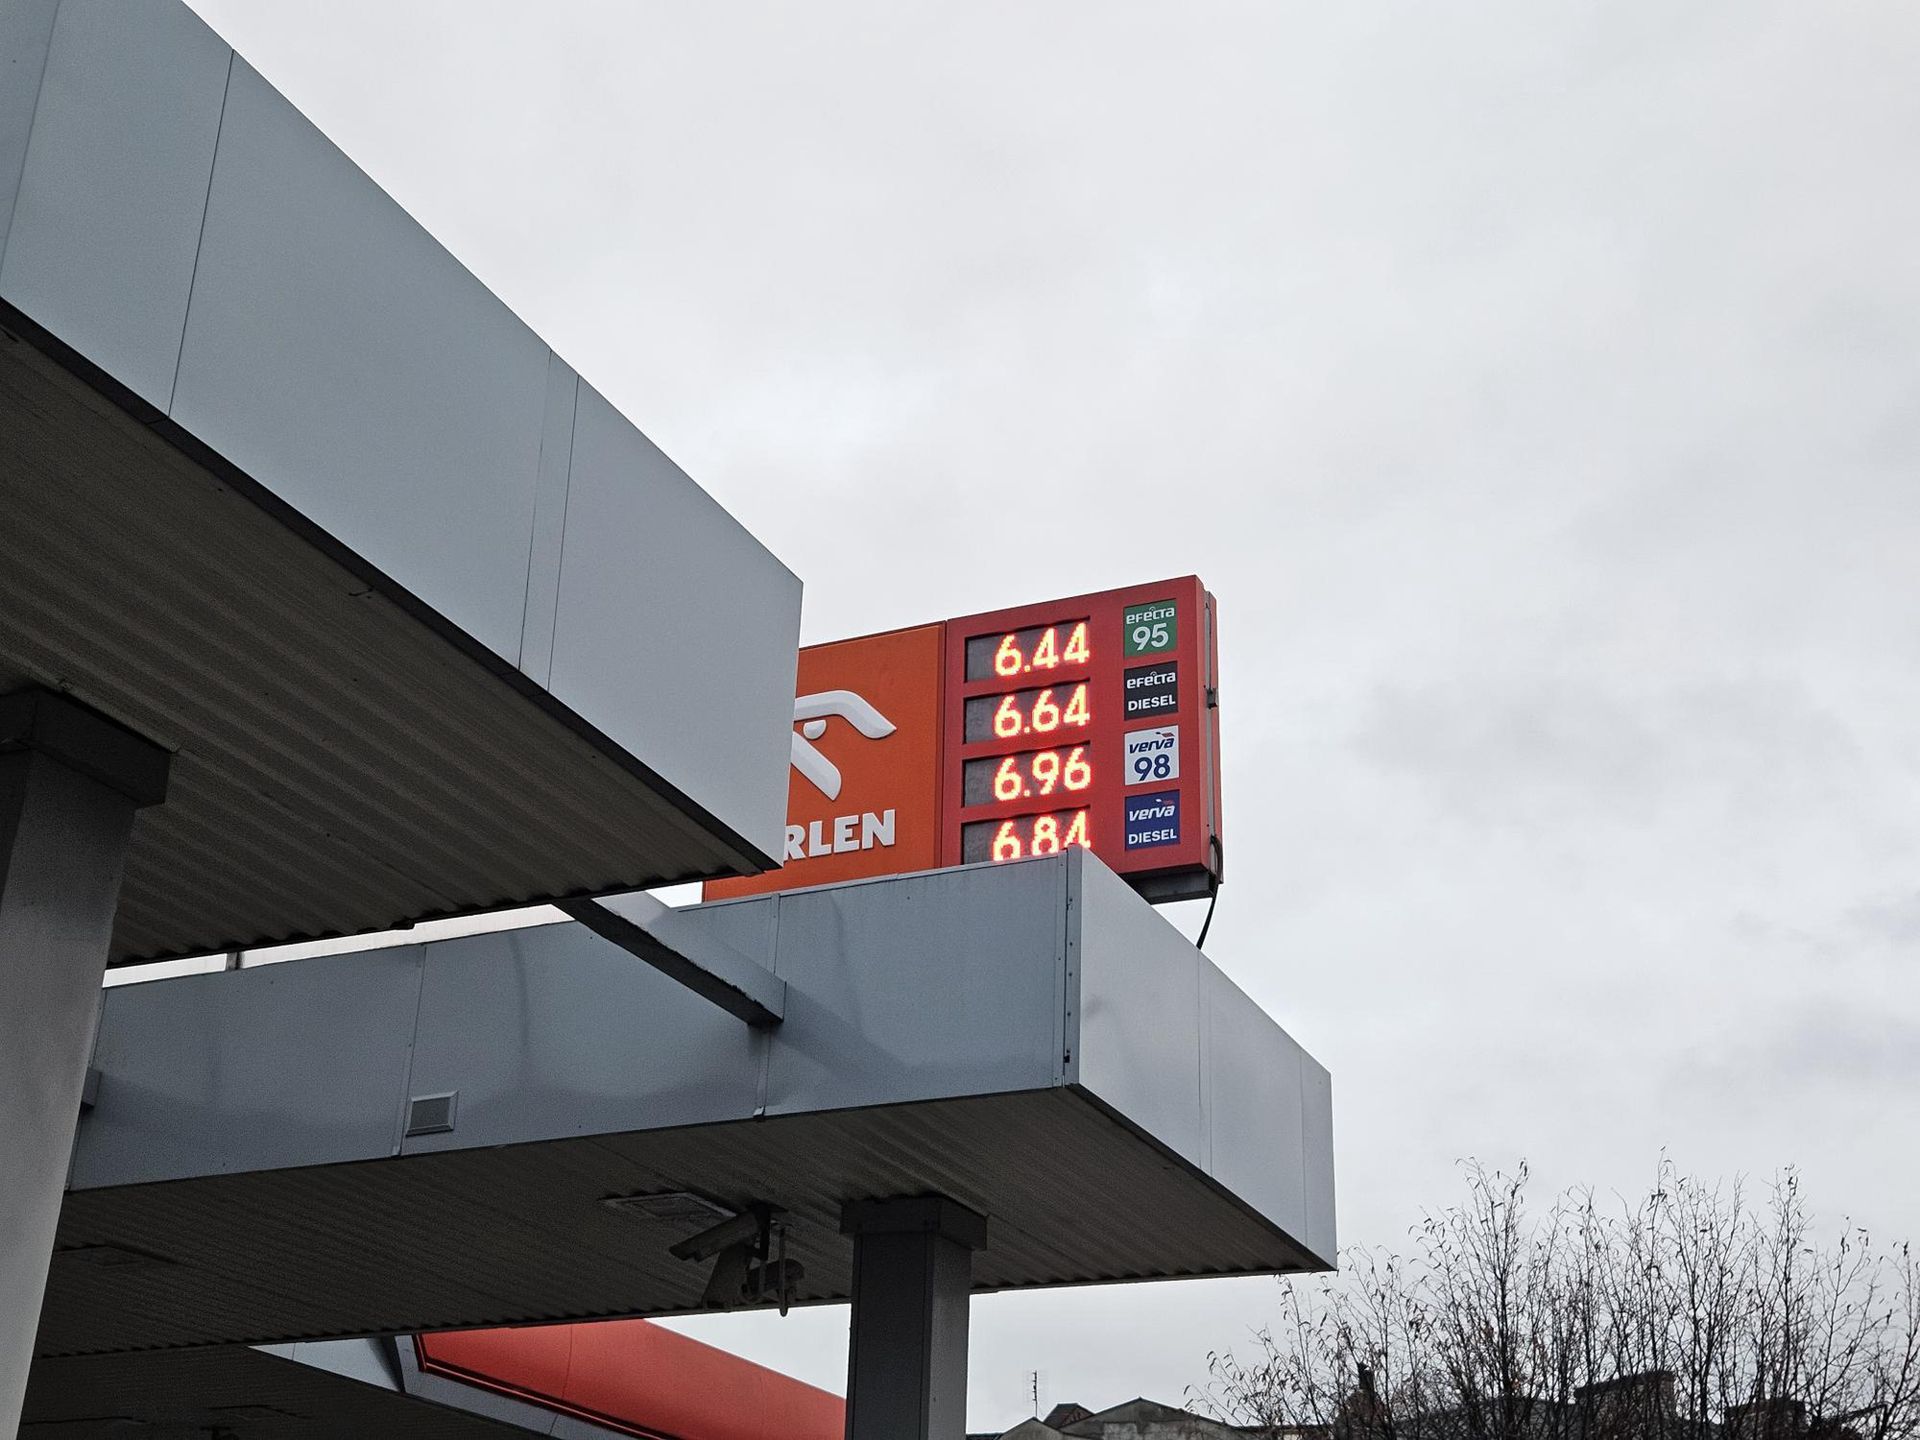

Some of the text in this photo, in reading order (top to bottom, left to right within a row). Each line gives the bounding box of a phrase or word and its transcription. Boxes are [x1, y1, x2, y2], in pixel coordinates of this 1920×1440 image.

[994, 621, 1090, 677] 6.44
[1132, 622, 1169, 651] 95
[993, 683, 1090, 739] 6.64
[1128, 694, 1177, 711] DIESEL
[1129, 737, 1175, 754] verva
[993, 747, 1091, 801] 6.96
[1134, 753, 1171, 782] 98
[1129, 804, 1176, 822] verva
[783, 809, 896, 861] RLEN
[993, 810, 1091, 862] 684
[1128, 828, 1178, 845] DIESEL
